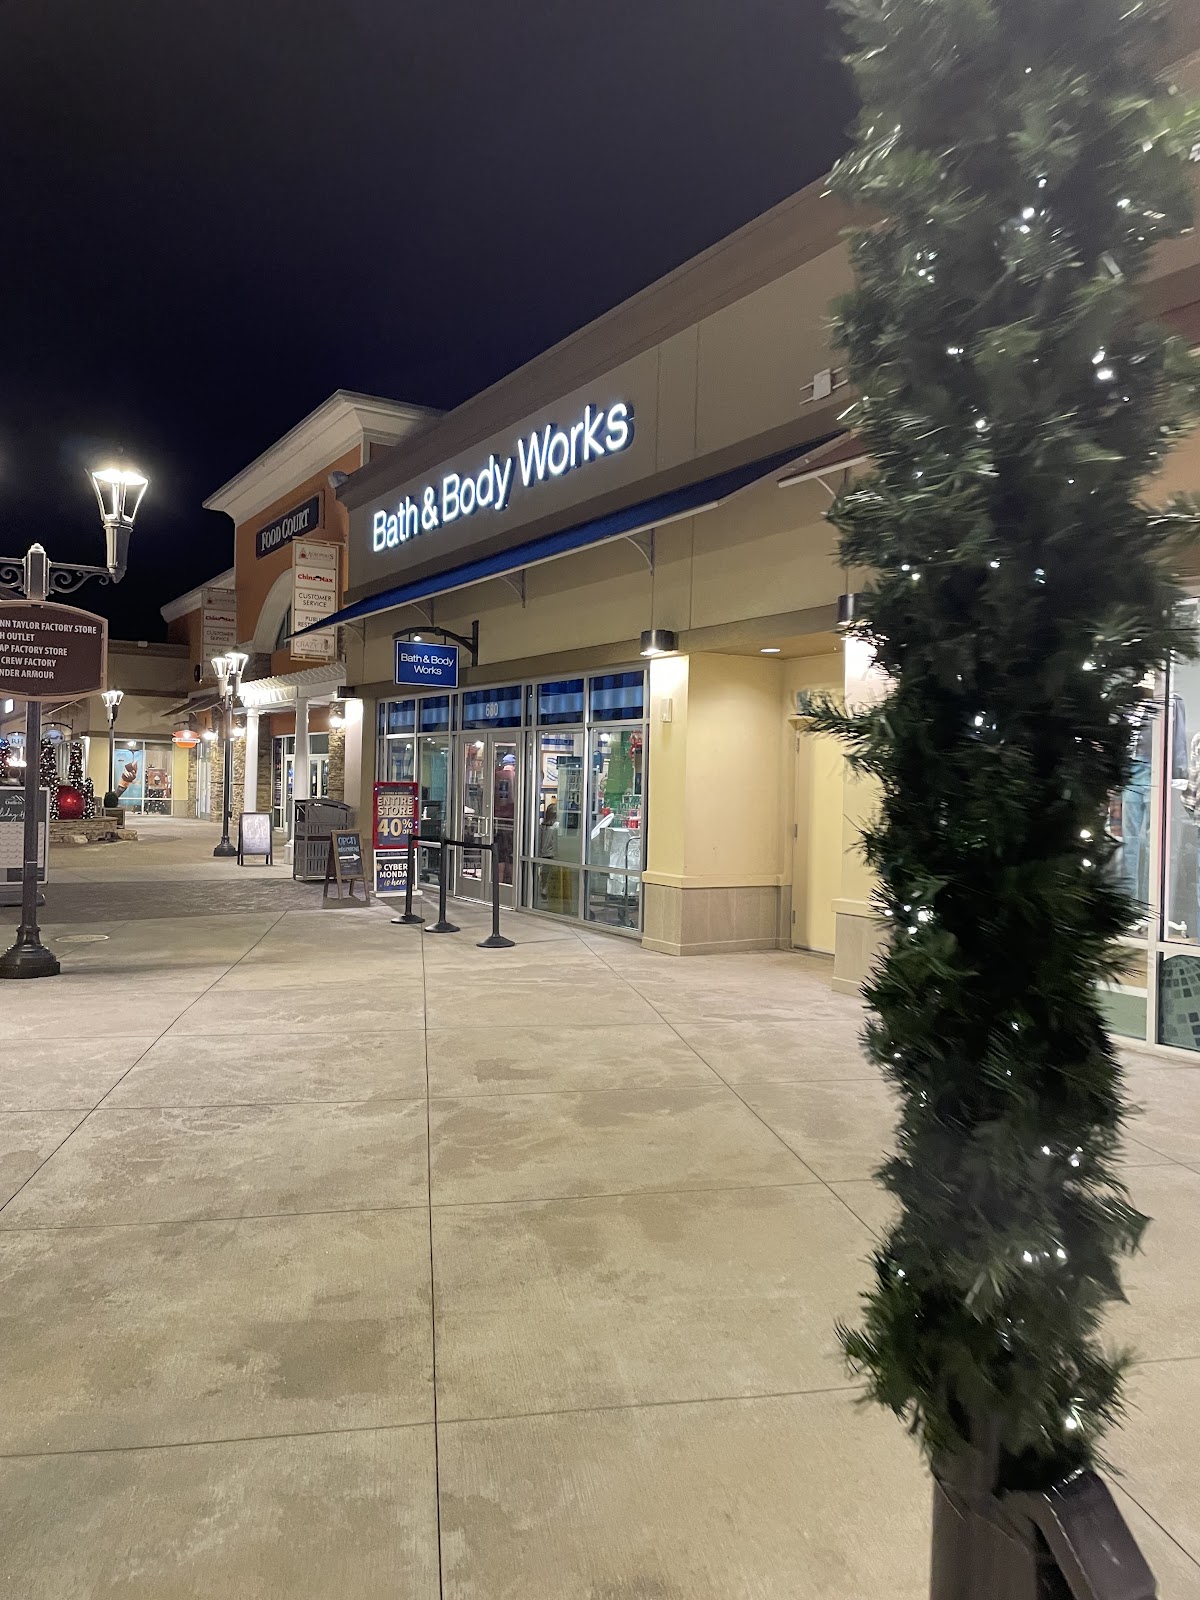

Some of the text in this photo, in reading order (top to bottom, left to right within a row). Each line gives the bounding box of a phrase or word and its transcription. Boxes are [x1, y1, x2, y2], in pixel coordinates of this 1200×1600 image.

[373, 402, 629, 552] Bath & Body Works
[261, 508, 310, 551] FOOD COURT
[298, 593, 332, 602] CUSTOMER
[303, 600, 327, 608] SERVICE
[12, 620, 40, 630] TAYLOR
[41, 623, 73, 632] FACTORY
[74, 625, 97, 634] STORE
[7, 632, 35, 642] OUTLET
[11, 645, 44, 655] FACTORY
[44, 647, 68, 656] STORE
[1, 656, 57, 668] CREW FACTORY
[401, 653, 454, 667] Bath & Body
[21, 669, 55, 679] ARMOUR
[414, 665, 443, 676] Works
[377, 796, 414, 806] ENTIRE
[377, 806, 414, 816] STORE
[383, 863, 408, 871] CYBER
